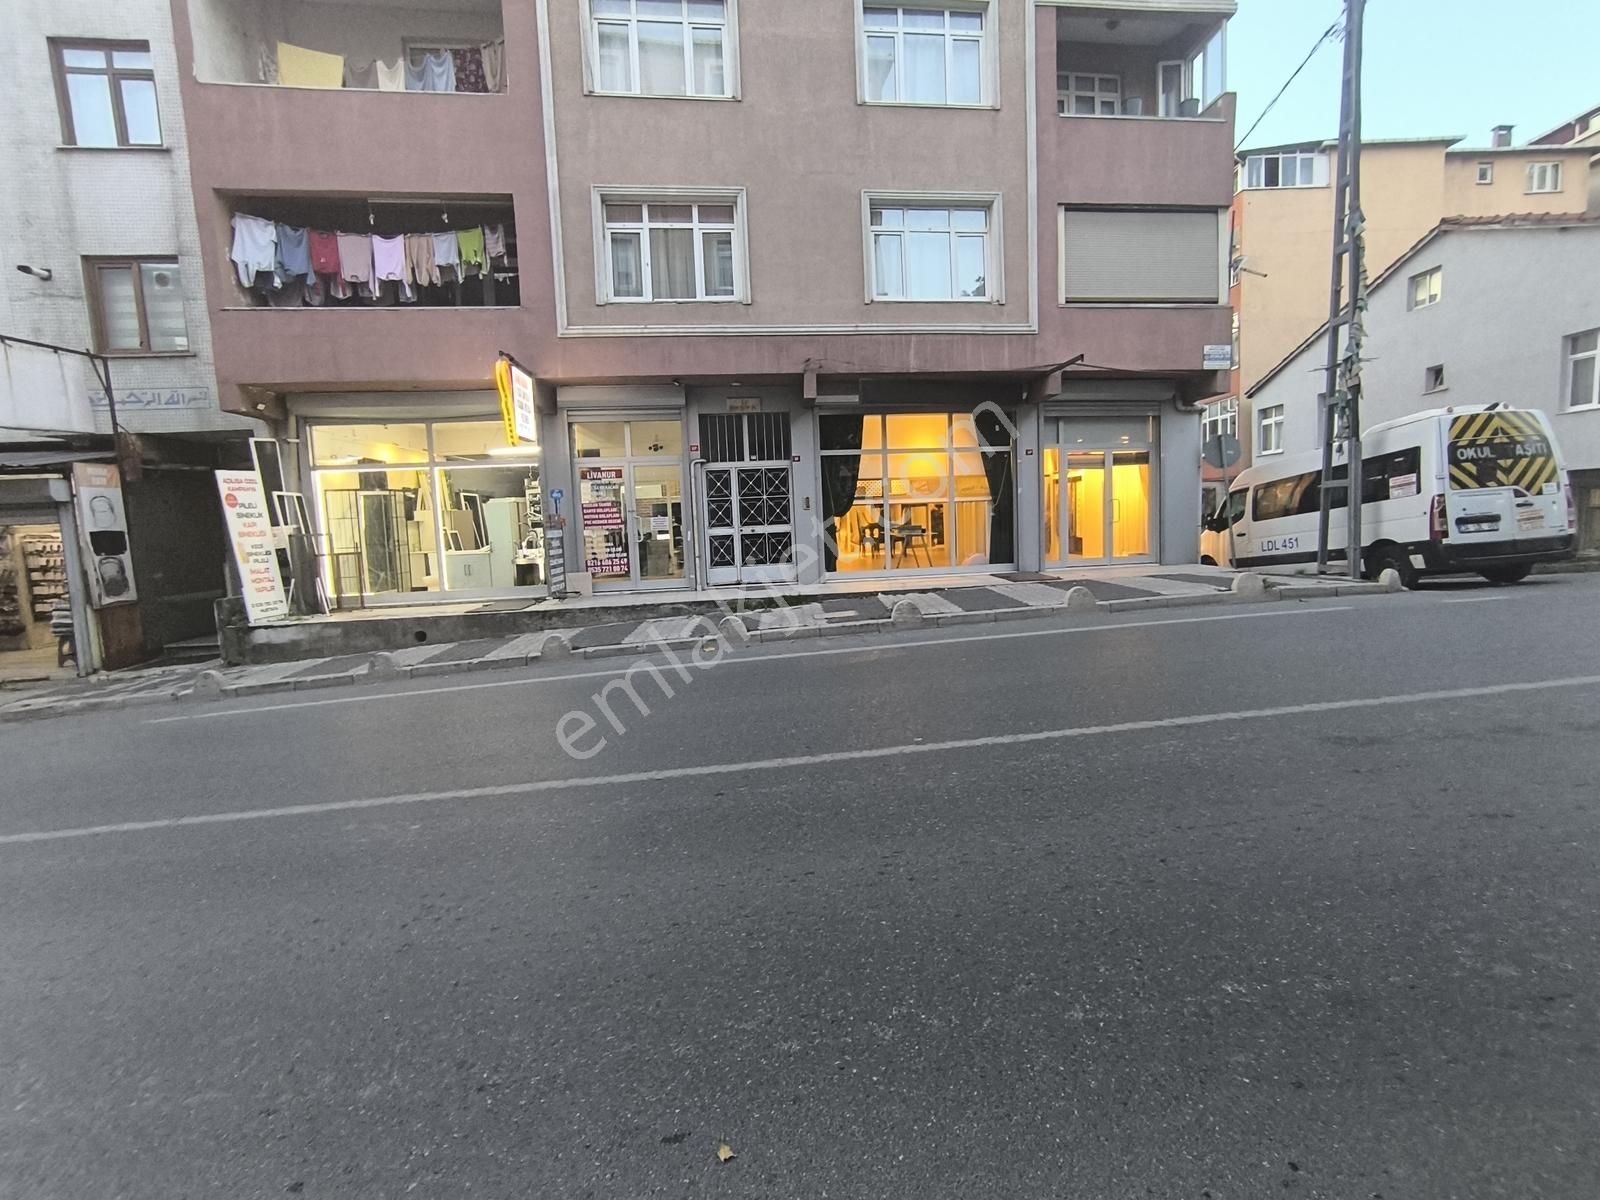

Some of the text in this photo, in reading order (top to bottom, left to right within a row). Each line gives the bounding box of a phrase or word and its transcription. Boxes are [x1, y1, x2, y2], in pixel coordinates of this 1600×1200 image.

[1457, 447, 1496, 460] OKUL
[1261, 537, 1299, 552] LDL 451
